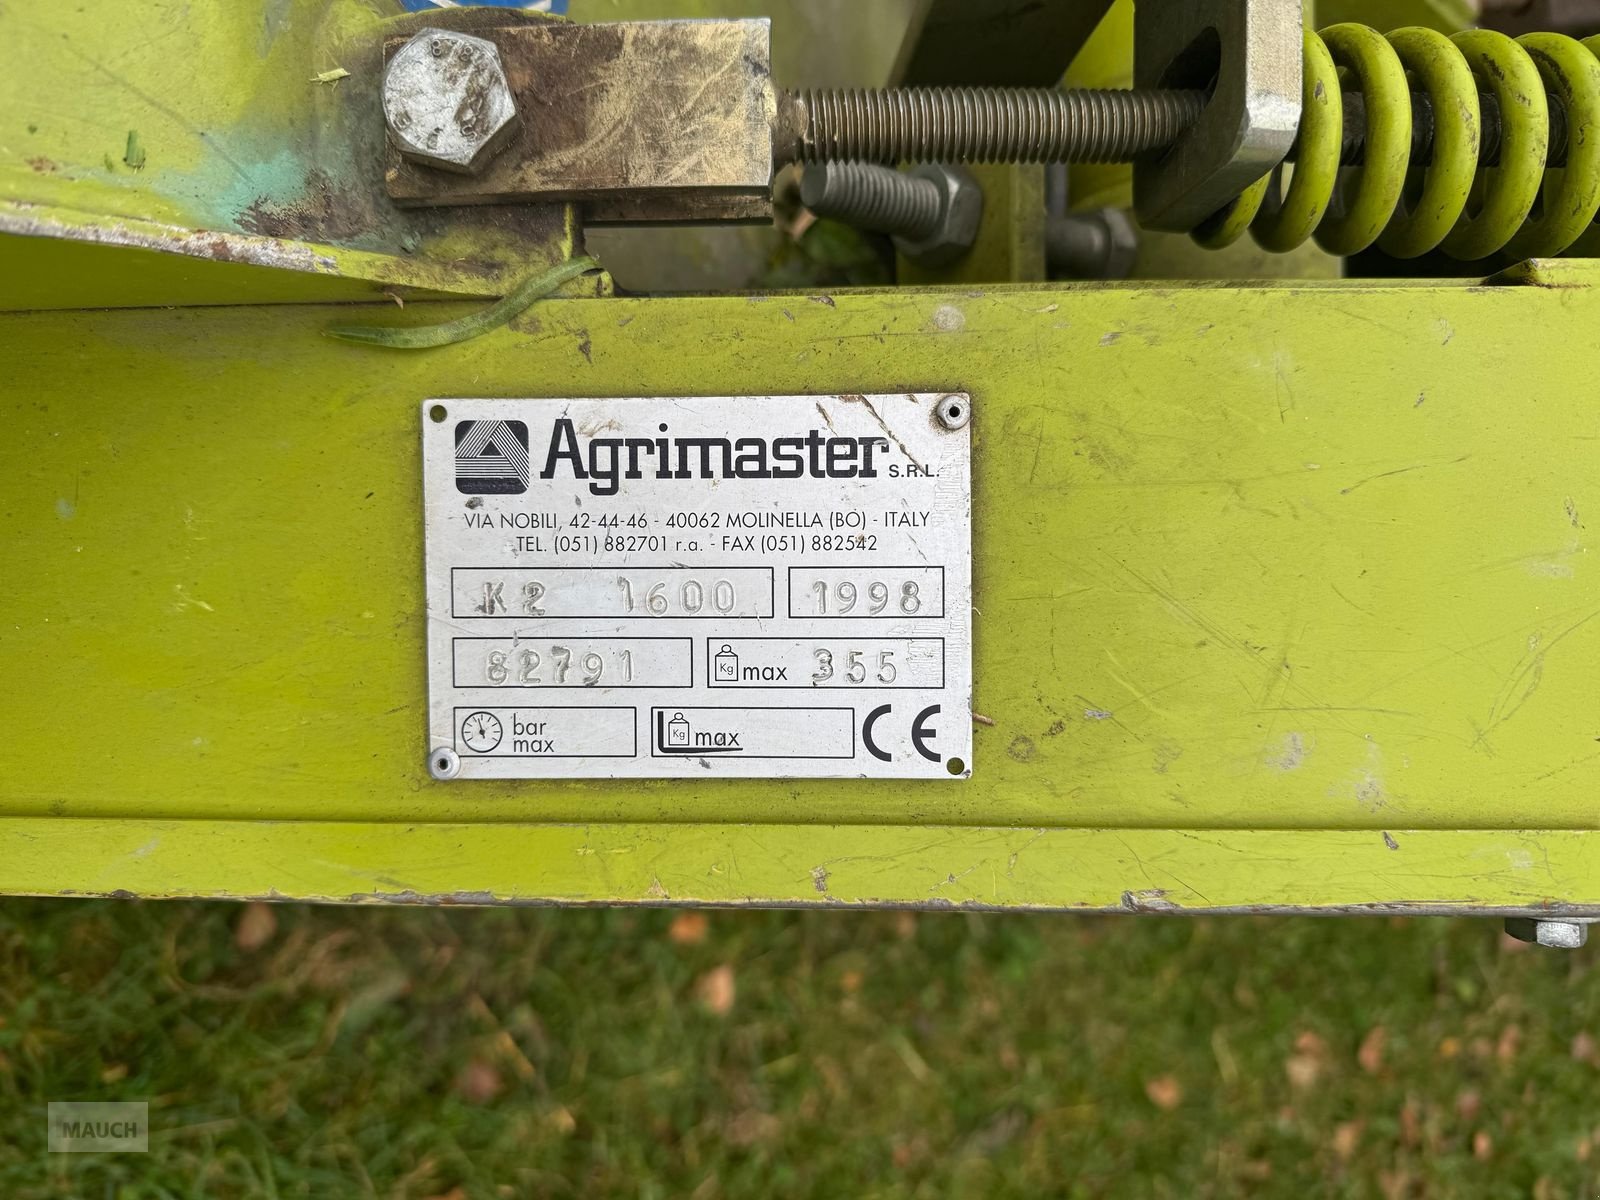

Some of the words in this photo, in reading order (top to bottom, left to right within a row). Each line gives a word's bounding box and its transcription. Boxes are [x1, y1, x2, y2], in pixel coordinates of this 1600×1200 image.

[540, 417, 890, 496] Agrimaster
[888, 463, 940, 478] S.R.L.
[465, 512, 495, 529] VIA
[500, 512, 562, 532] NOBILI,
[569, 512, 648, 529] 42-44-46
[665, 512, 720, 529] 40062
[726, 512, 825, 529] MOLINELLA
[829, 511, 867, 531] (BO)
[885, 511, 930, 528] ITALY
[516, 536, 546, 552] TEL.
[554, 535, 598, 555] (051)
[604, 535, 666, 552] 882701
[676, 541, 704, 552] r.a.
[722, 535, 755, 552] FAX
[761, 534, 805, 555] (051)
[811, 534, 878, 552] 882542
[479, 581, 546, 616] K2
[616, 576, 736, 616] 1600
[813, 580, 921, 615] 1998
[486, 646, 634, 686] 82791
[742, 666, 788, 681] max
[812, 648, 897, 685] 355
[513, 712, 547, 736] bar
[695, 732, 740, 747] max
[862, 703, 942, 763] CE
[513, 739, 555, 753] max
